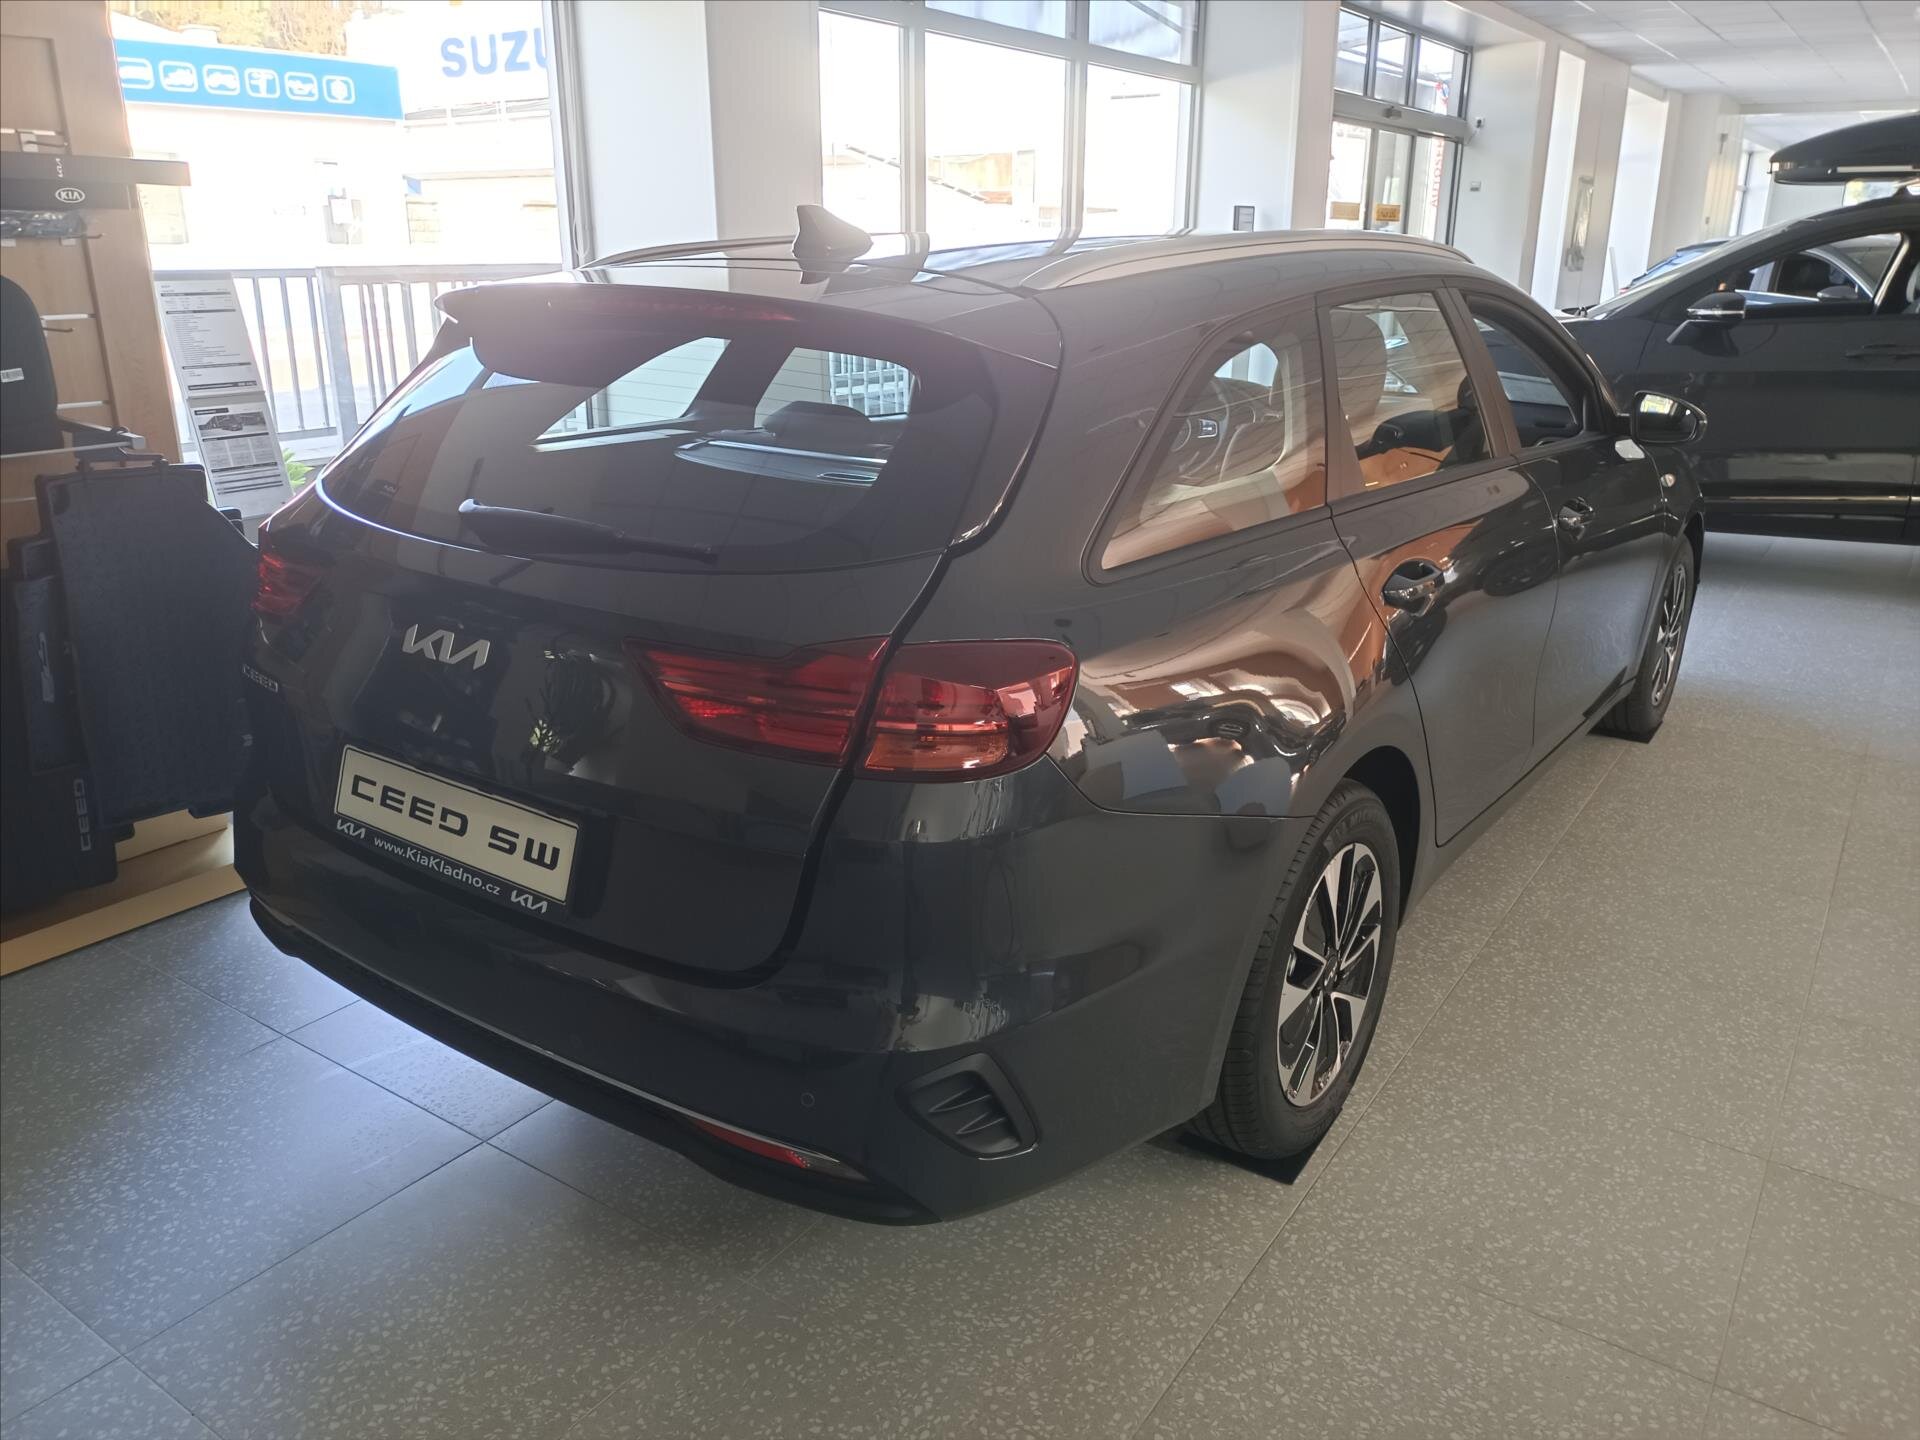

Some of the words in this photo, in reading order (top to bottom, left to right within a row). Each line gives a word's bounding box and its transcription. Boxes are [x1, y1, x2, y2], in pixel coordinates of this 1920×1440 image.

[59, 190, 82, 201] KIA
[402, 624, 490, 670] KIA
[242, 664, 278, 693] CEED
[74, 779, 91, 851] CEED
[351, 774, 469, 837] CEED
[488, 825, 561, 871] SW
[336, 818, 367, 840] KIA
[374, 836, 501, 896] www.KiaKladno.cz
[510, 889, 548, 914] KIA
